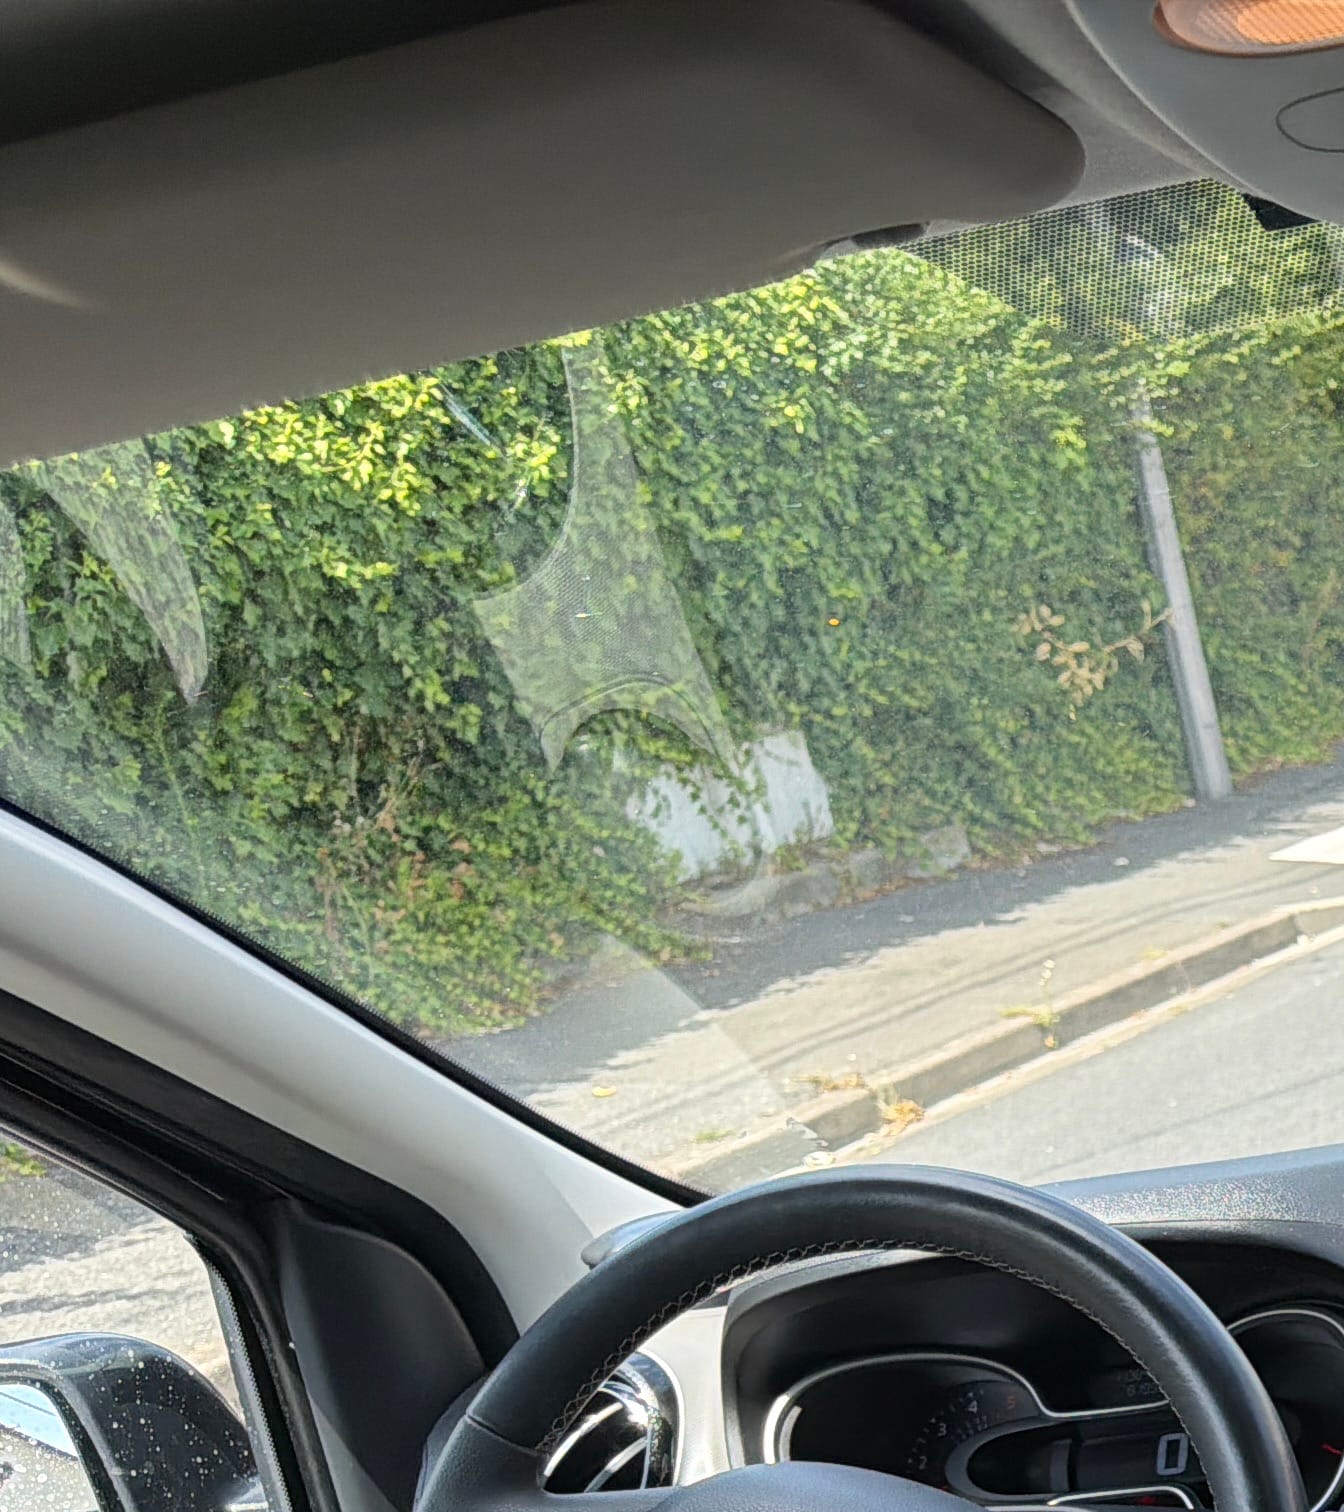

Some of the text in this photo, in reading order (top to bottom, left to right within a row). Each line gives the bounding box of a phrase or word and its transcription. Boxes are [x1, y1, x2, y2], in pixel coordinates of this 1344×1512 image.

[967, 1399, 978, 1414] 4
[937, 1422, 947, 1437] 3
[1156, 1432, 1189, 1477] 0
